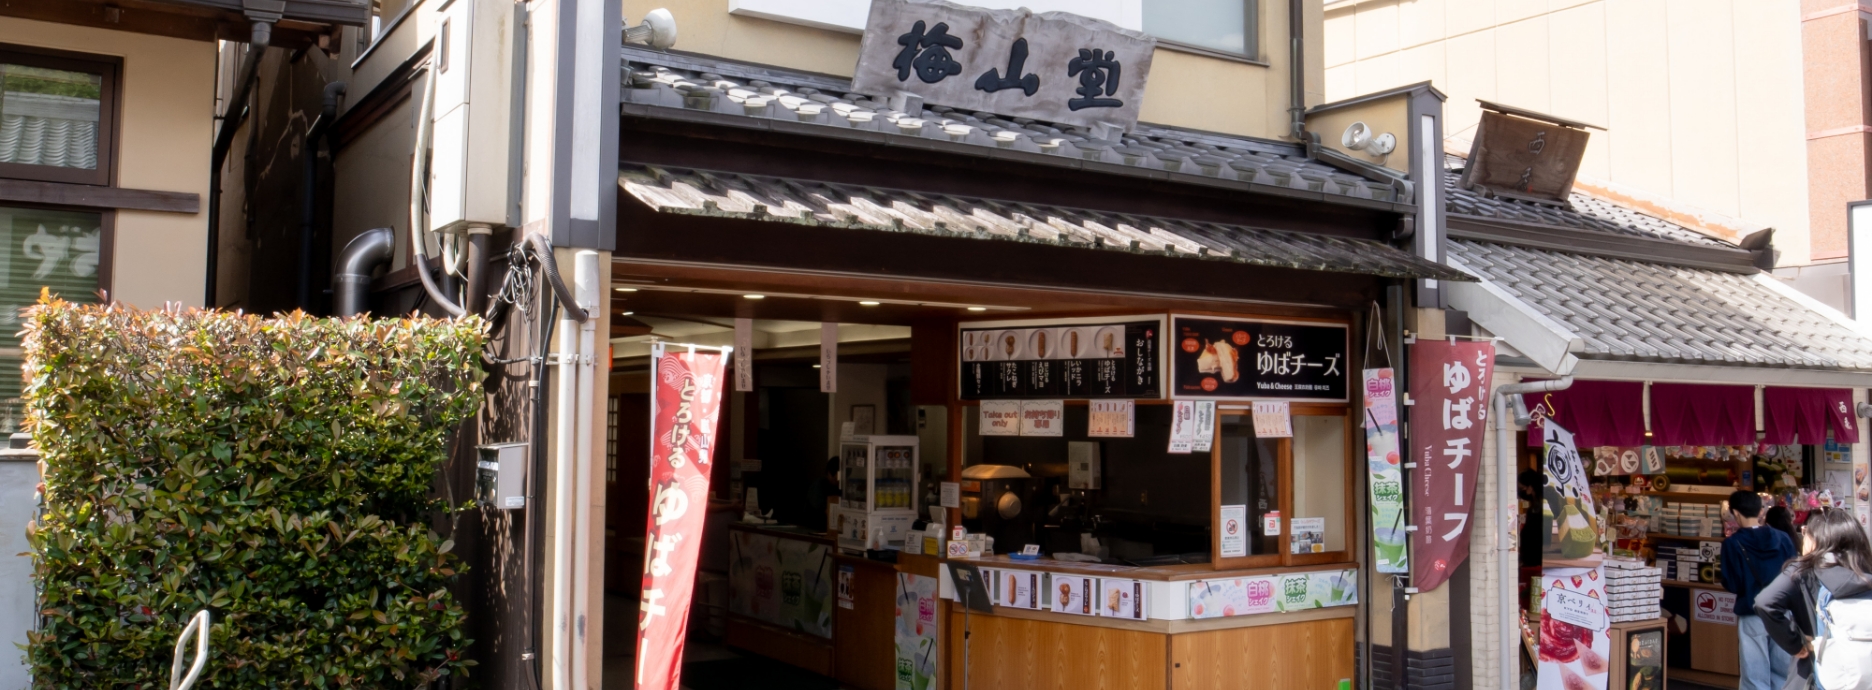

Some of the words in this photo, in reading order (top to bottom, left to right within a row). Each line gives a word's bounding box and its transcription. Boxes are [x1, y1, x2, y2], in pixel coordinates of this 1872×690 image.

[892, 20, 1123, 111] 梅山堂
[1257, 334, 1293, 348] とろける
[1135, 338, 1145, 386] おしながき
[1257, 351, 1341, 377] ゆばチーズ
[1275, 382, 1293, 390] Cheese
[1367, 378, 1392, 391] 白桃
[1368, 390, 1391, 398] シェイク
[983, 410, 1003, 418] Take
[1004, 410, 1018, 418] out
[668, 378, 696, 470] とろける
[991, 419, 1008, 428] only
[1424, 445, 1433, 467] Yuba
[1373, 481, 1399, 495] 抹茶
[1424, 467, 1432, 497] Cheese
[782, 570, 802, 595] 抹茶
[1247, 580, 1270, 598] 白桃
[1285, 577, 1307, 596] 抹茶
[918, 597, 935, 615] 白桃
[1248, 597, 1269, 606] シェイク
[1286, 594, 1306, 604] シェイク
[898, 657, 914, 674] 抹茶
